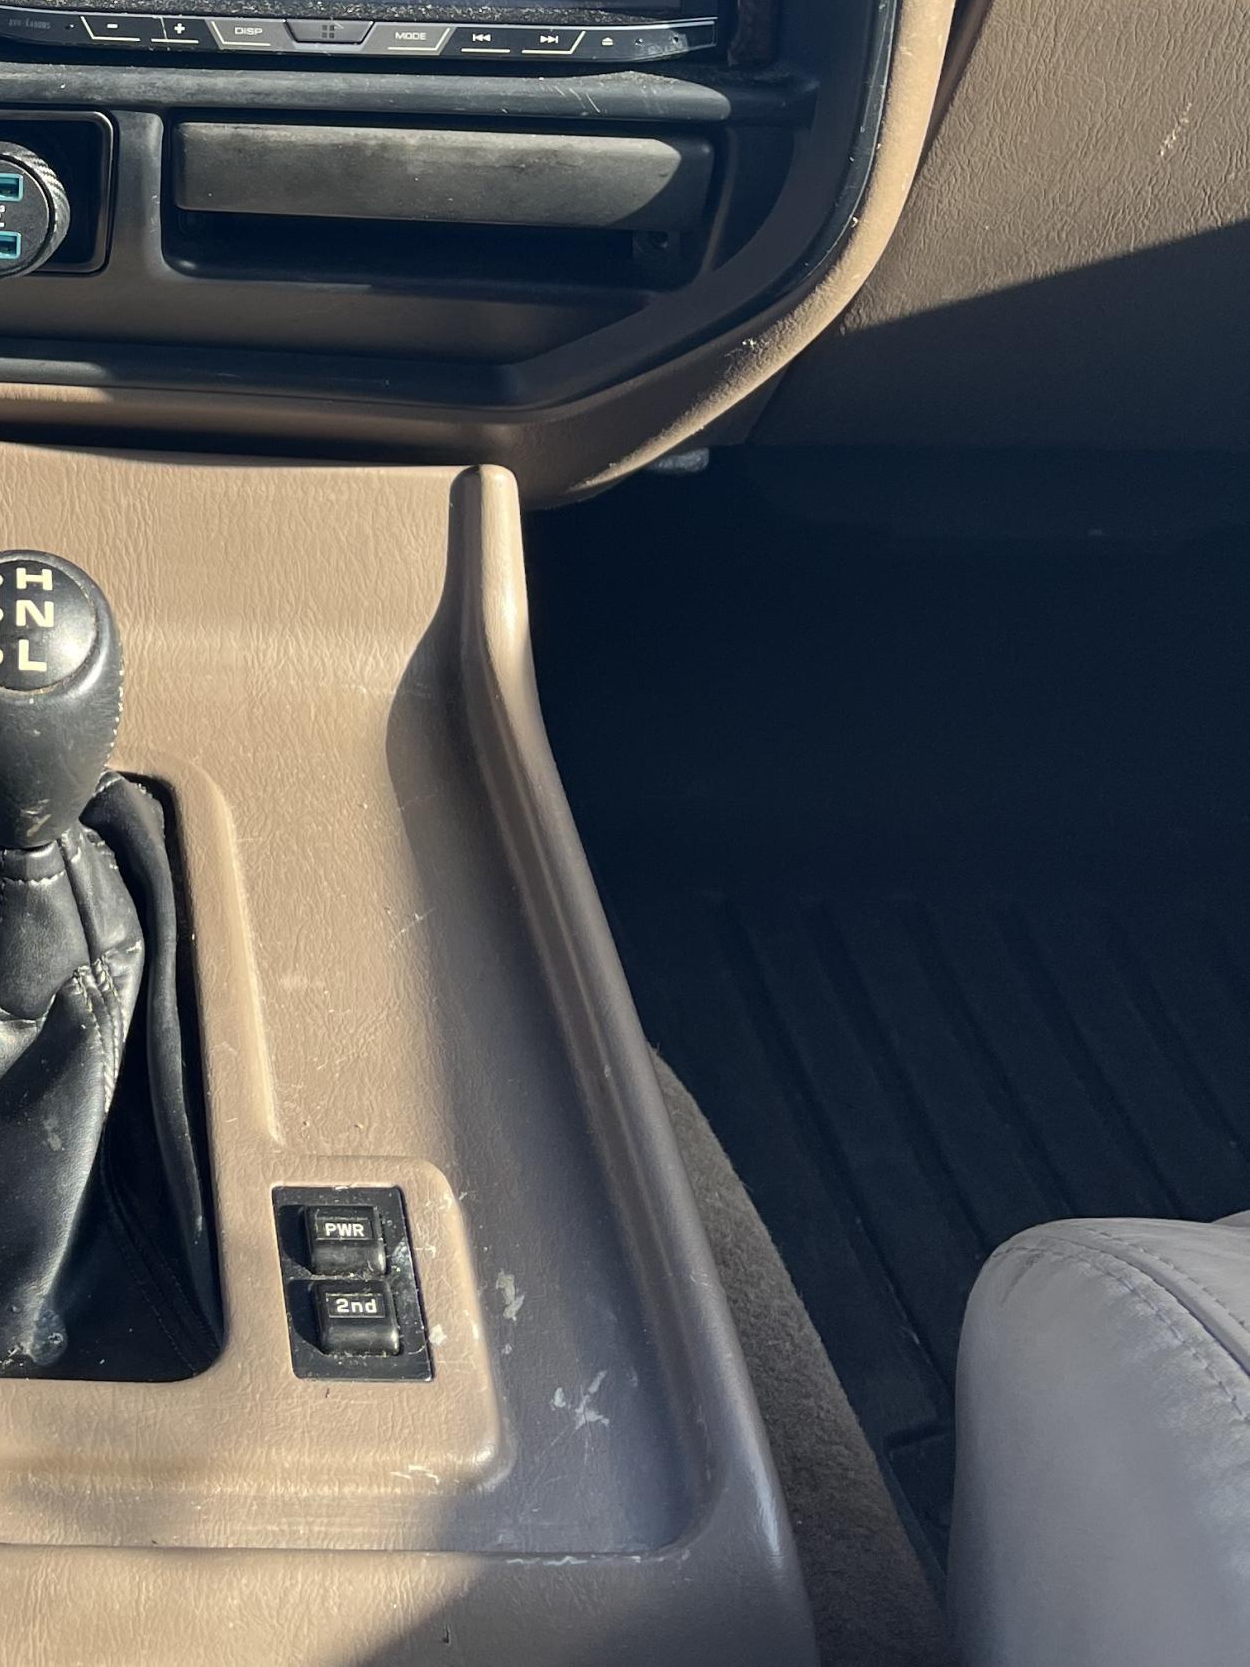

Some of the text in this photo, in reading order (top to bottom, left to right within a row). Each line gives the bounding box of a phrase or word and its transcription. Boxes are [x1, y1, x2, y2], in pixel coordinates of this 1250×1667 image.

[234, 26, 263, 36] DISP
[394, 31, 427, 41] MODE
[15, 567, 53, 591] H
[15, 599, 55, 628] N
[18, 638, 48, 672] L
[324, 1221, 366, 1238] PWR
[335, 1297, 378, 1314] 2nd
